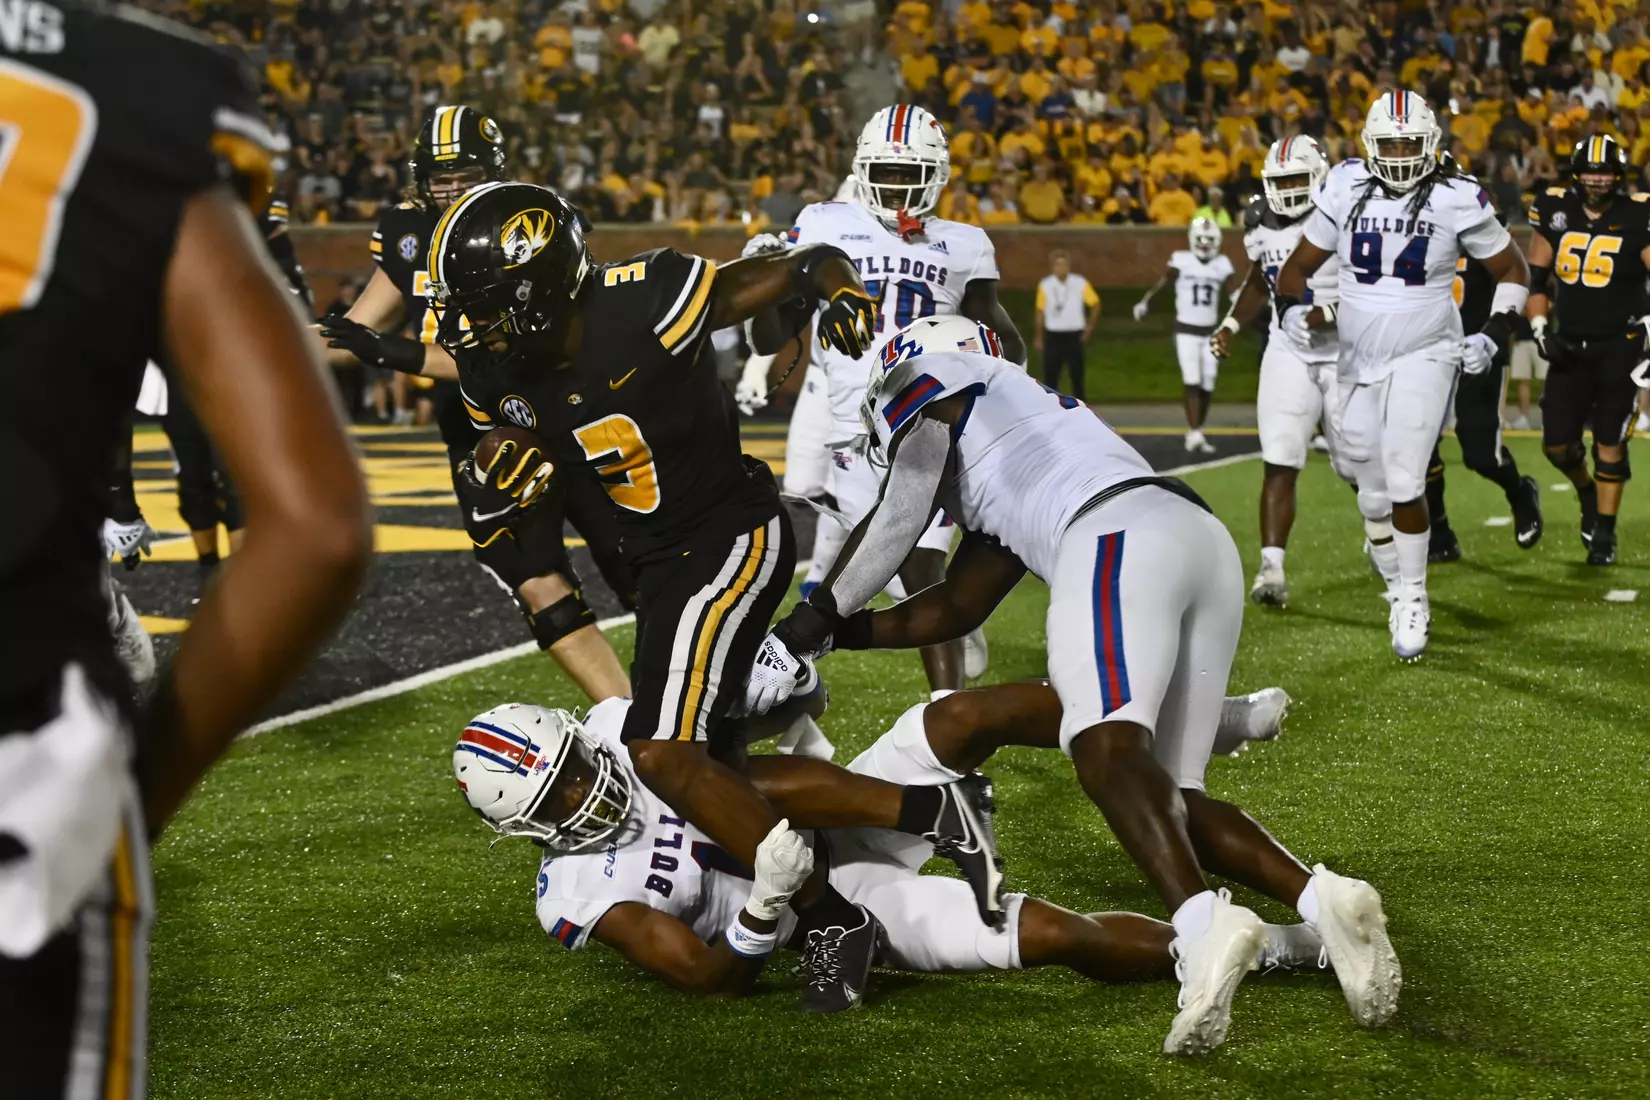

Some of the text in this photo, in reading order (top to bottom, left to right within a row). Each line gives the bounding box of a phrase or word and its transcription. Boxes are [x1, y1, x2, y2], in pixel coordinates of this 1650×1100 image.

[1355, 217, 1435, 237] ULLDOGS
[605, 261, 646, 287] 3
[850, 255, 948, 287] ULLDOGS
[1351, 232, 1430, 287] 94
[1555, 231, 1623, 288] 66
[1192, 283, 1213, 306] 13
[503, 399, 533, 428] SEC
[572, 413, 661, 514] 3
[764, 640, 788, 672] adidas
